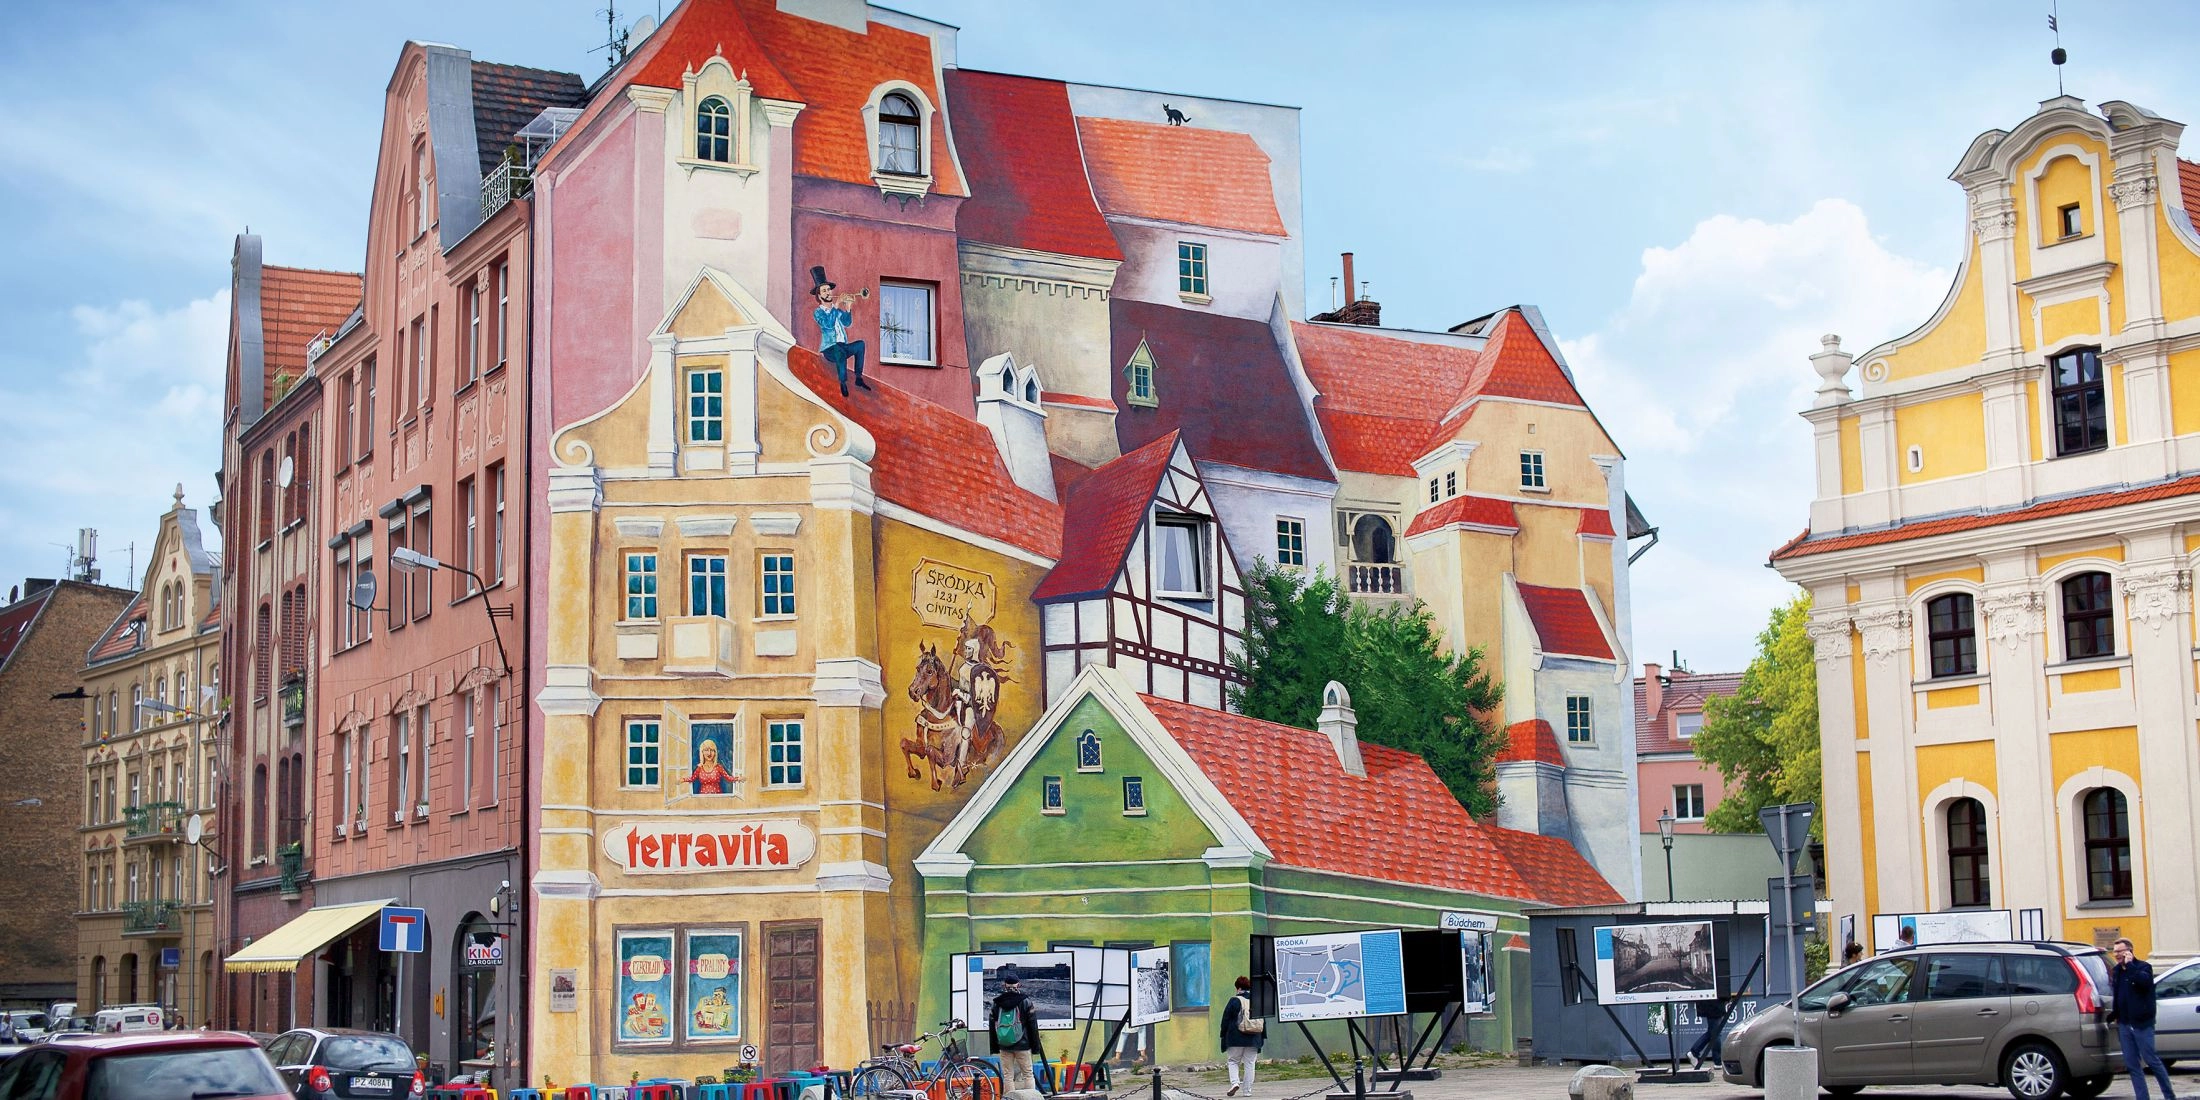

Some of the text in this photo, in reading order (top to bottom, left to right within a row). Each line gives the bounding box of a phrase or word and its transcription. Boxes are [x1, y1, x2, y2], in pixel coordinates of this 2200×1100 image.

[926, 569, 985, 599] ŚRÓDKA
[935, 590, 957, 603] 1231
[627, 824, 788, 867] terravita
[1448, 918, 1485, 928] Budchem
[1276, 939, 1304, 947] ŚRÓDKA
[468, 948, 502, 959] KINO
[700, 958, 726, 973] PRALINY
[355, 1078, 366, 1087] PZ
